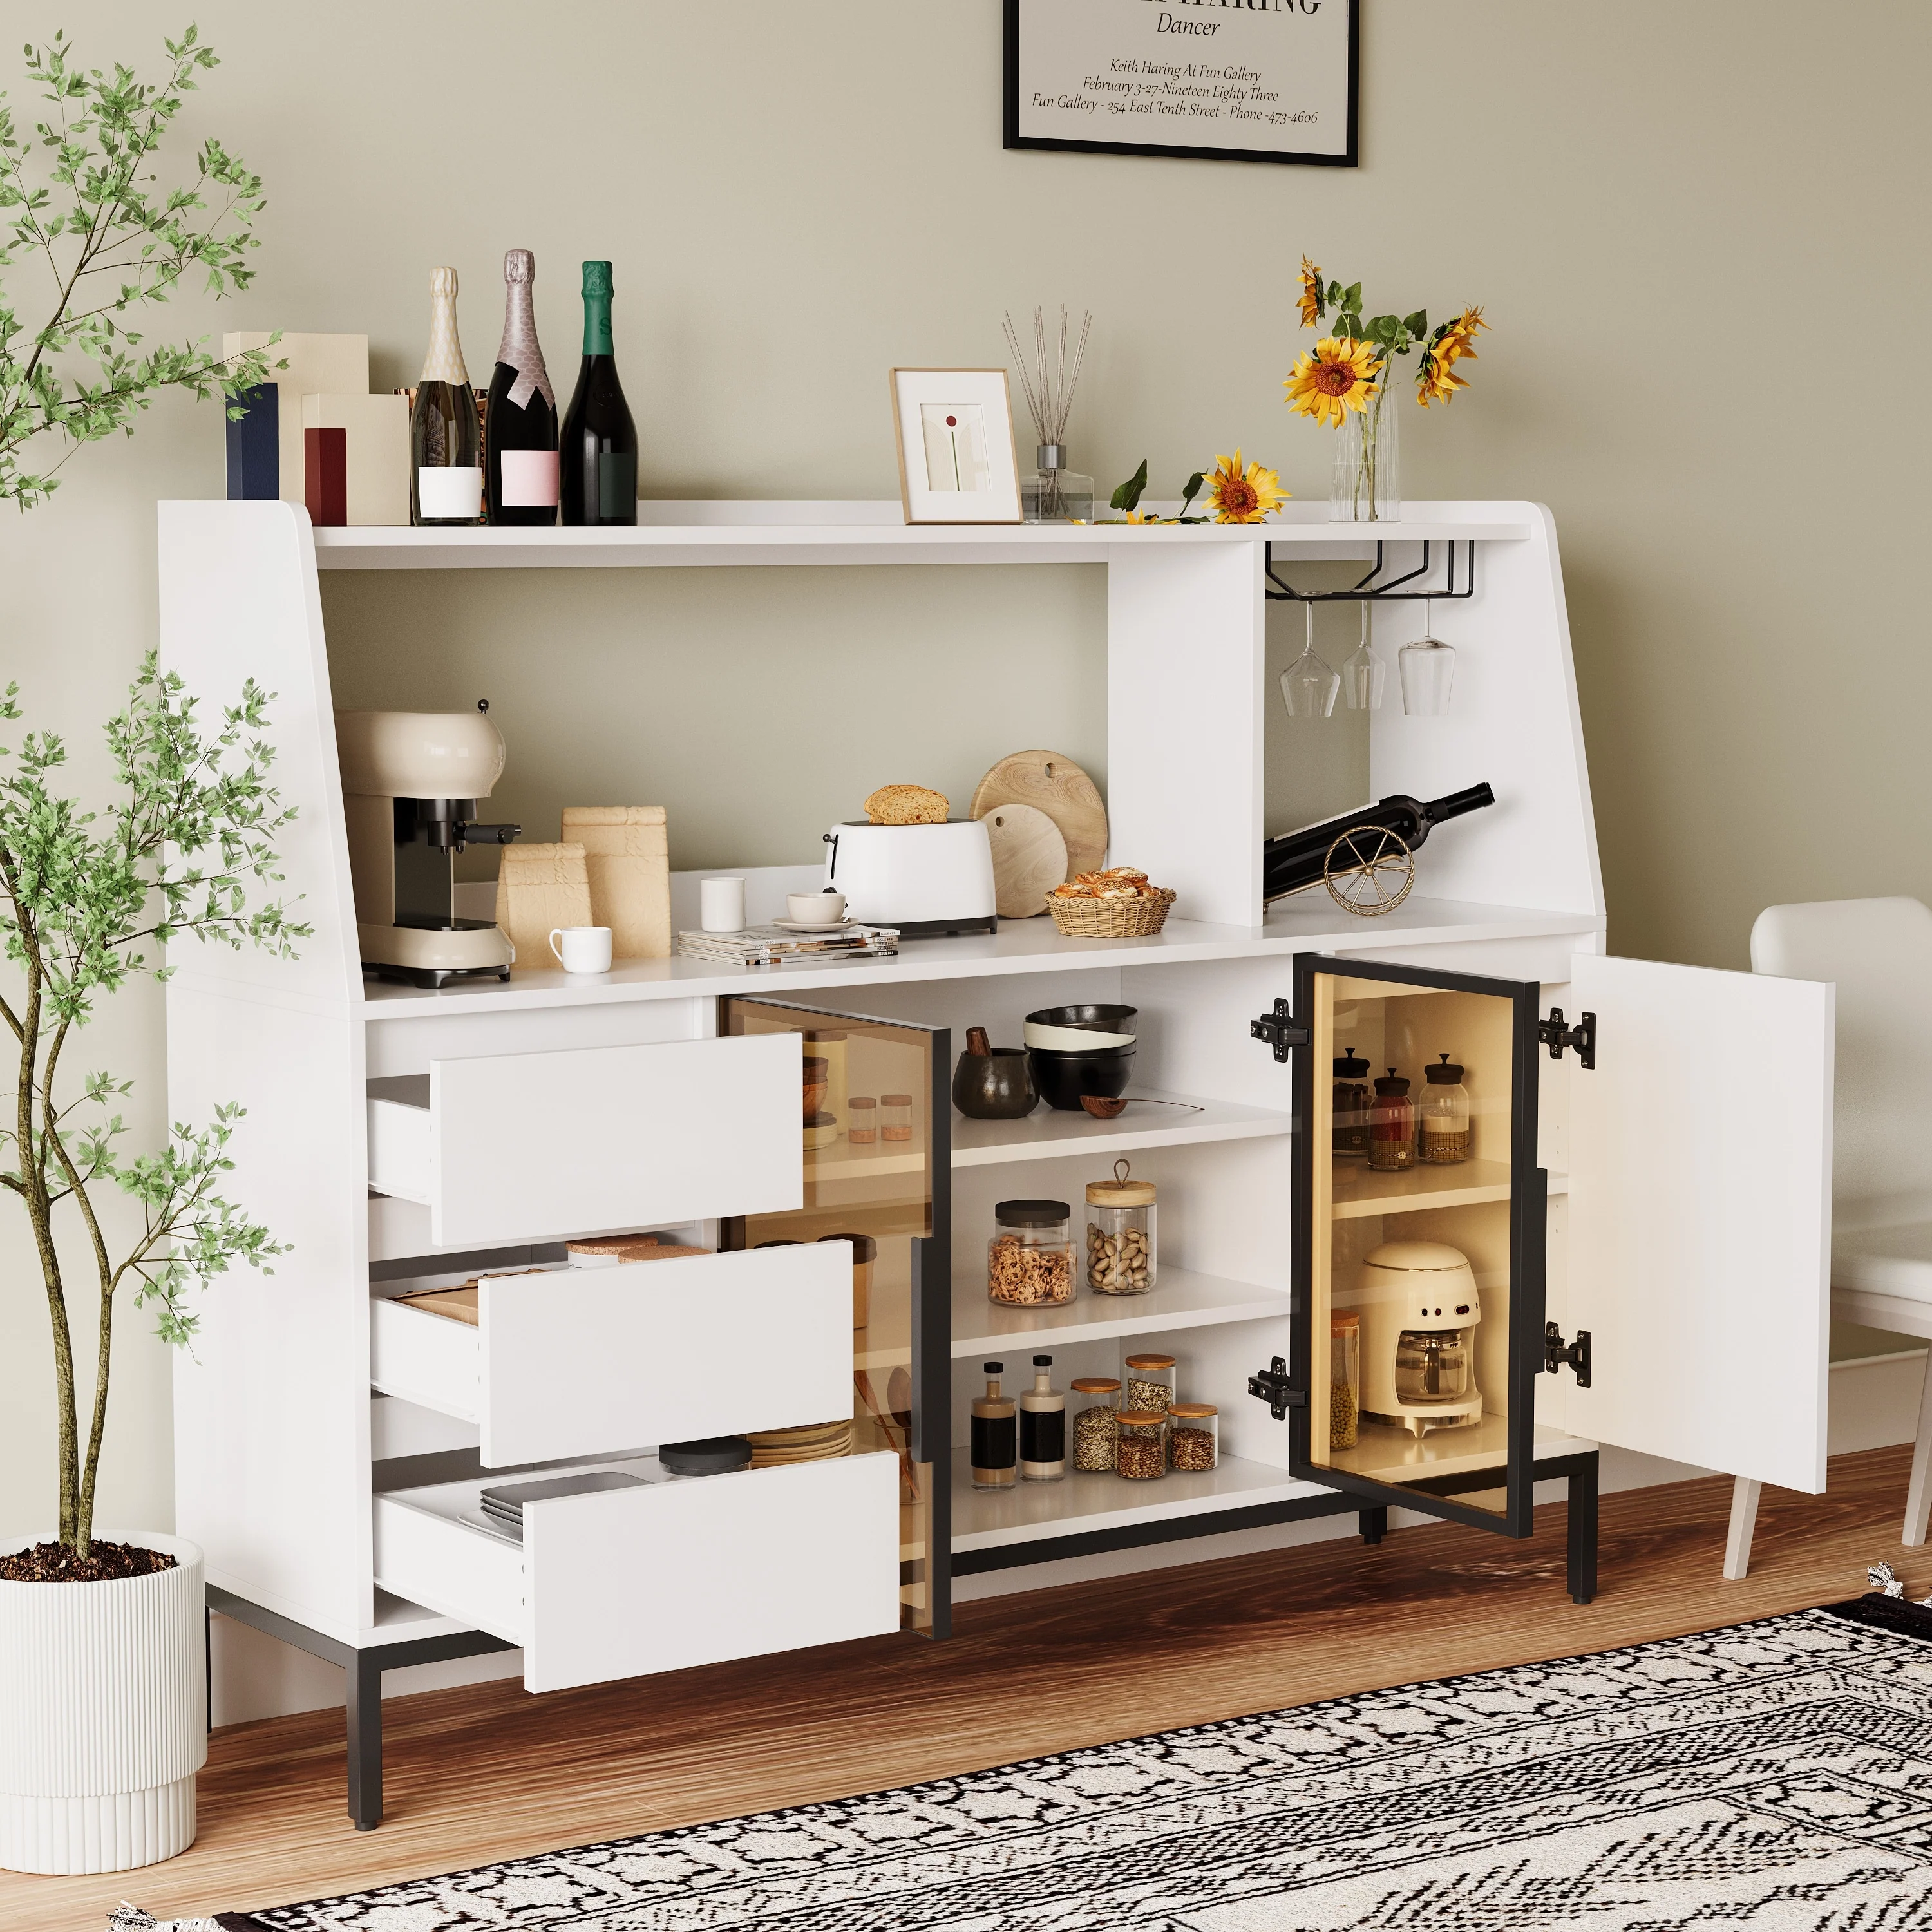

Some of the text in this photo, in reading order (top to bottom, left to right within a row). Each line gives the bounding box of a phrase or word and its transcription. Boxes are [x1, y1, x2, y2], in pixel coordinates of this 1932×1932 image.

[1157, 12, 1221, 36] Dancer
[1110, 57, 1262, 86] Keith Haring At Fun Gallery
[1083, 75, 1134, 97] February
[1213, 84, 1247, 104] Eighty
[1249, 86, 1279, 102] Three
[1032, 93, 1054, 108] Fun
[1057, 93, 1099, 115] Gallery
[1107, 102, 1126, 115] 254
[1130, 99, 1154, 113] East
[1157, 100, 1186, 115] Tenth
[1188, 102, 1220, 118] Street
[1229, 104, 1263, 120] Phone
